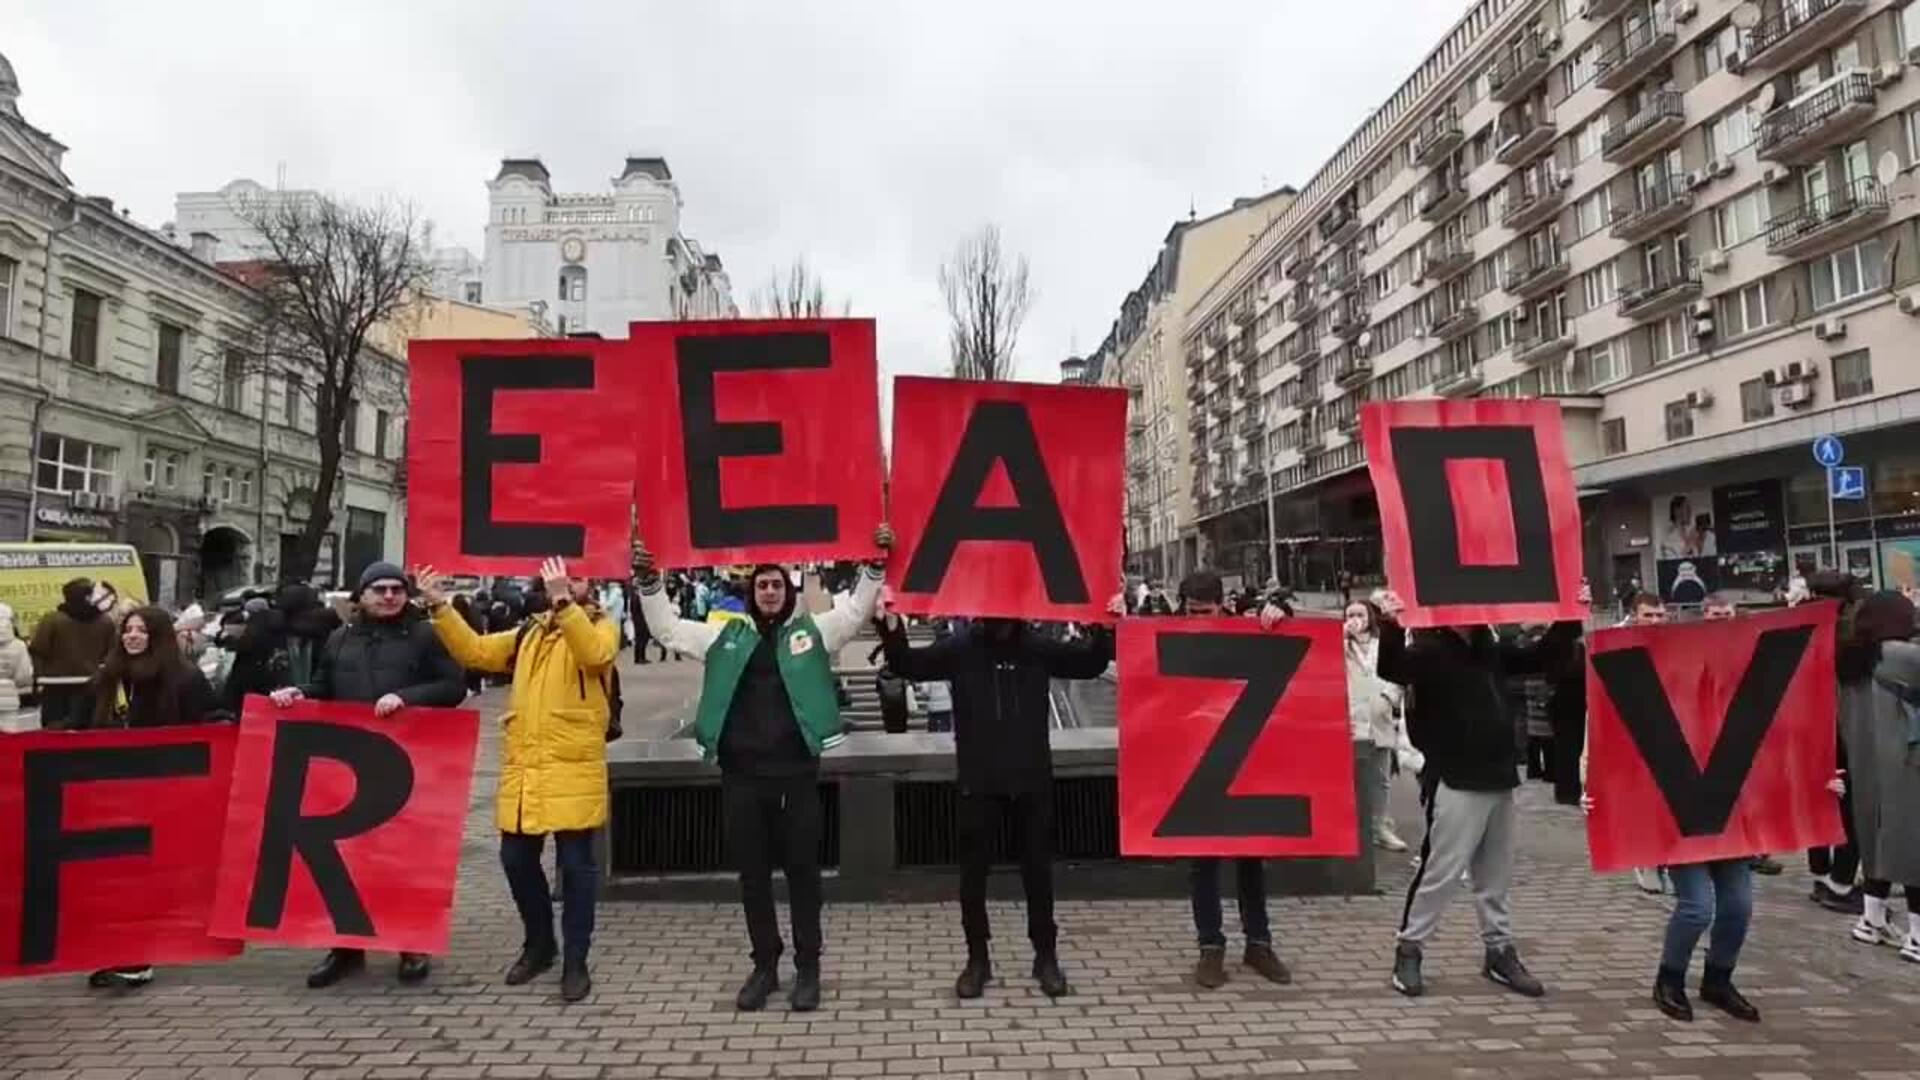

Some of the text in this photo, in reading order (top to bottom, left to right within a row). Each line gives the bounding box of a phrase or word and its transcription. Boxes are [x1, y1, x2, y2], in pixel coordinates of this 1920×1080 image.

[461, 355, 594, 557] E
[676, 332, 837, 548] E
[904, 401, 1087, 603] A
[1391, 427, 1558, 606] O
[247, 720, 414, 936] R
[1157, 633, 1311, 837] Z
[1591, 624, 1815, 836] V
[19, 742, 210, 966] F
